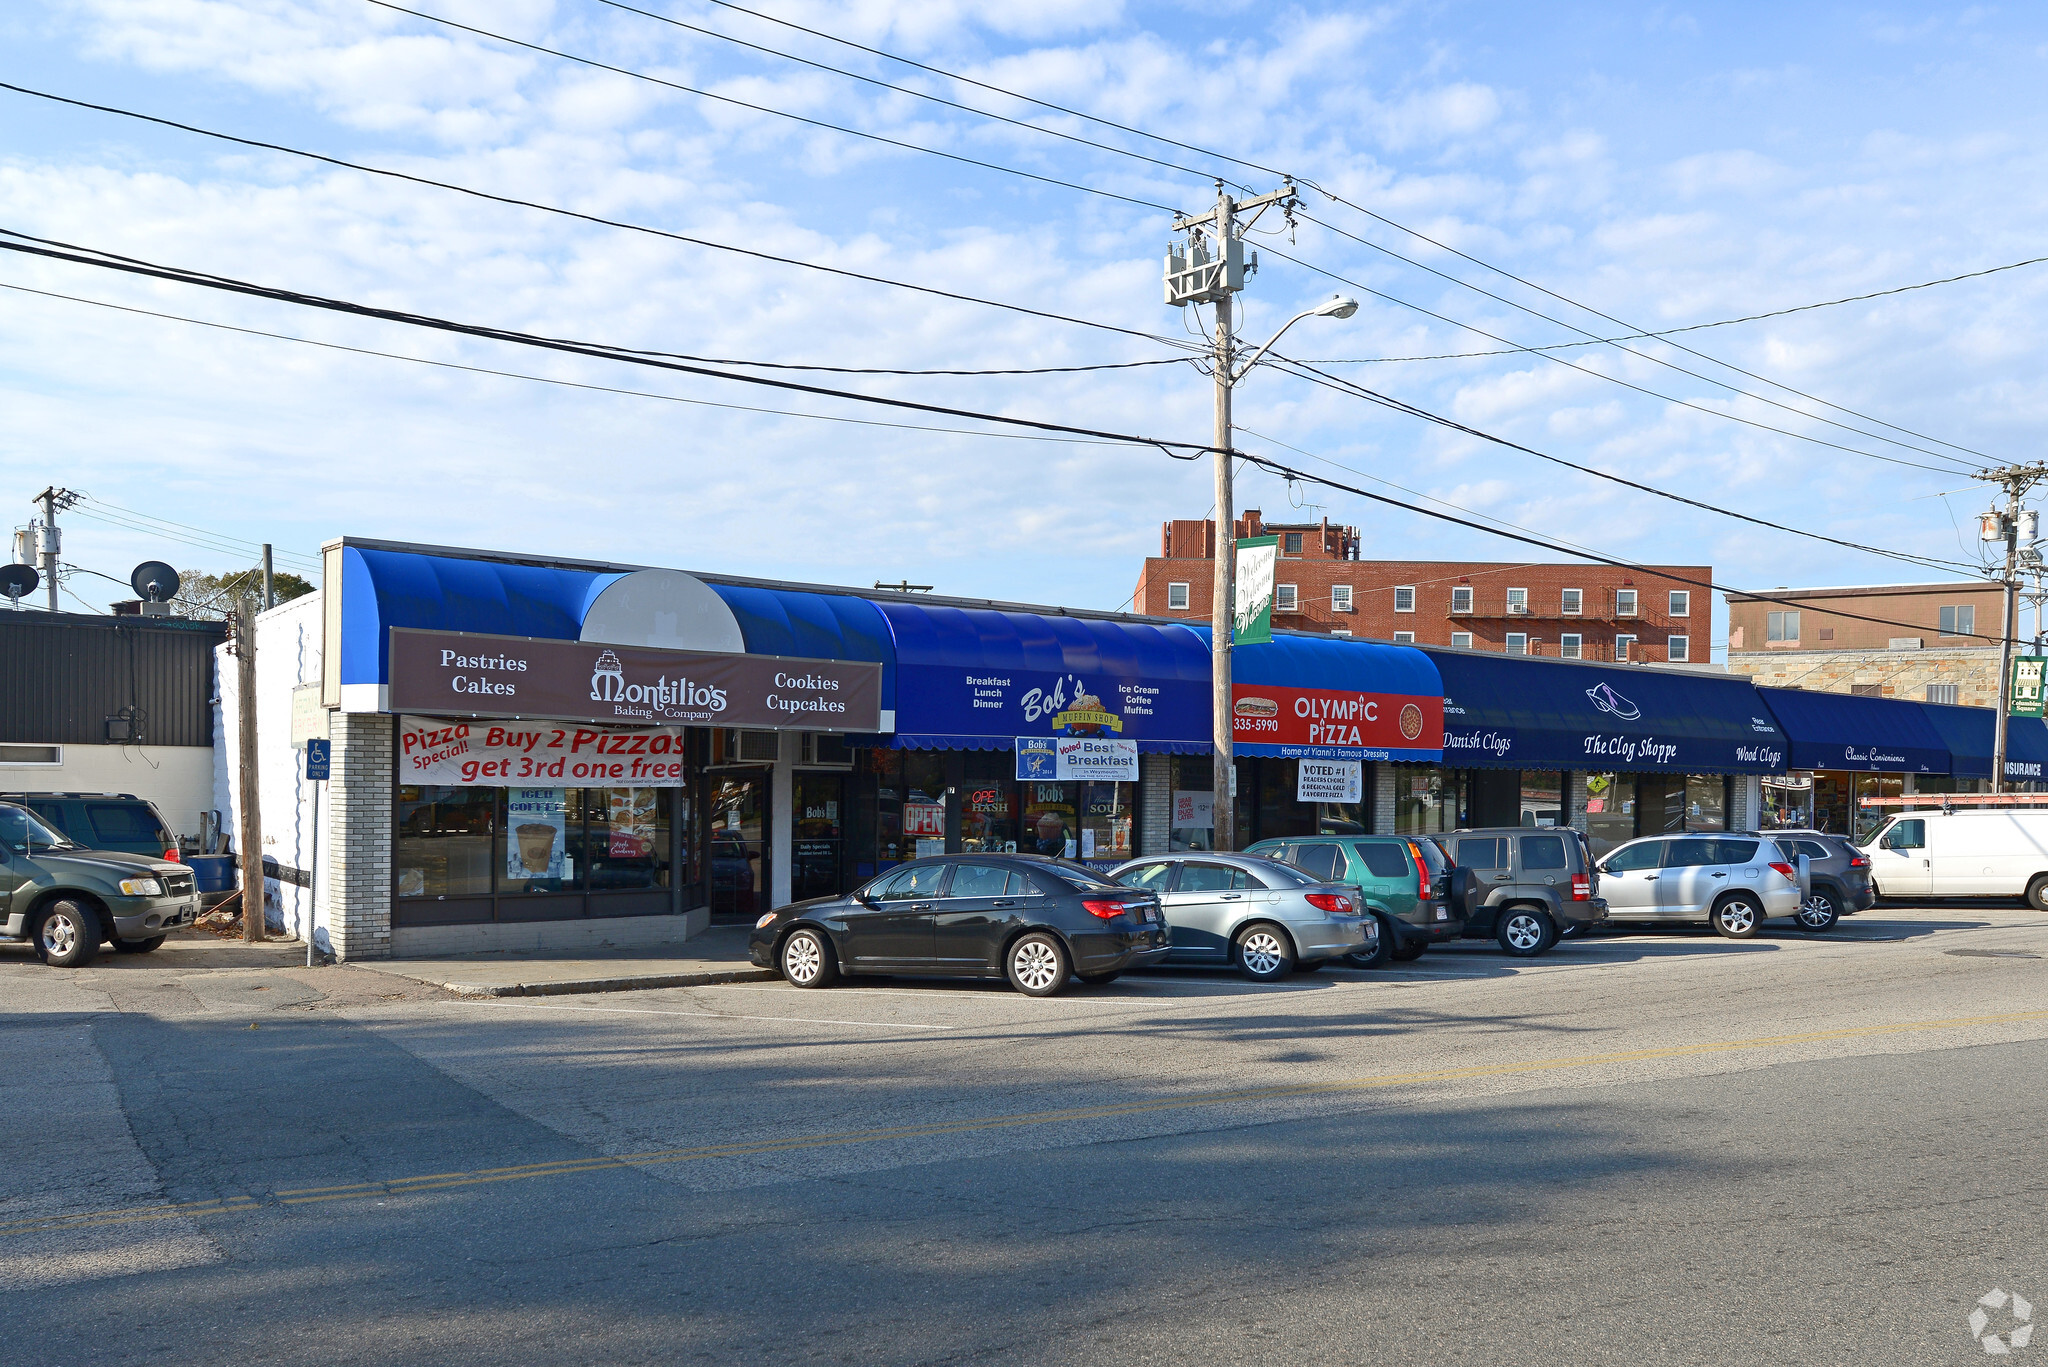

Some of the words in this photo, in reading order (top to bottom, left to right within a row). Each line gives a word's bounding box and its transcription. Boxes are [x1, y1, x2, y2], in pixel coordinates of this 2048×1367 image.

[1236, 593, 1270, 635] Welcome
[440, 649, 528, 672] Pastries
[451, 675, 516, 696] Cakes
[774, 672, 839, 691] Cookies
[966, 676, 1011, 687] Breakfast
[1118, 684, 1132, 693] Ice
[1133, 685, 1160, 695] Cream
[590, 671, 727, 712] Montilio's
[974, 687, 1002, 698] Lunch
[1021, 674, 1086, 723] Bob's
[766, 694, 845, 713] Cupcakes
[973, 699, 1003, 709] Dinner
[1125, 695, 1152, 705] Coffee
[2011, 699, 2042, 707] Columbian
[614, 705, 653, 719] Baking
[664, 707, 714, 721] Company
[1062, 712, 1092, 723] MUFFIN
[1094, 713, 1114, 724] SHOP
[1124, 705, 1153, 715] Muffins
[1233, 718, 1278, 732] 335-5990
[402, 723, 470, 755] Pizza
[485, 726, 542, 754] Buy
[547, 729, 567, 748] 2
[570, 728, 684, 755] Pizzas
[1028, 740, 1047, 749] Bob's
[1443, 730, 1481, 749] Danish
[1482, 731, 1511, 757] Clogs
[412, 740, 469, 770] Special!
[1059, 740, 1081, 756] Voted
[1083, 742, 1115, 753] Best
[1281, 746, 1303, 756] Home
[1303, 747, 1310, 756] of
[1337, 748, 1362, 758] Famous
[1363, 749, 1389, 760] Dressing
[1584, 734, 1607, 754] The
[1608, 735, 1636, 762] Clog
[1638, 737, 1677, 764] Shoppe
[1845, 745, 1868, 761] Classic
[1869, 746, 1905, 763] Convenience
[1067, 755, 1134, 766] Breakfast
[1736, 745, 1758, 762] Wood
[1759, 746, 1781, 768] Clogs
[308, 763, 329, 771] PARKING
[461, 758, 512, 783] get
[517, 756, 567, 778] 3rd
[571, 762, 624, 778] one
[1303, 765, 1334, 776] VOTED
[1335, 767, 1346, 777] #1
[2004, 761, 2042, 777] NSURANCE
[521, 788, 553, 799] ICED
[1037, 783, 1064, 803] Bob's
[1177, 796, 1192, 805] GRAB
[971, 803, 1009, 812] HASH
[1089, 804, 1125, 813] SOUP
[1177, 808, 1194, 816] ENJOY
[905, 807, 943, 833] OPEN
